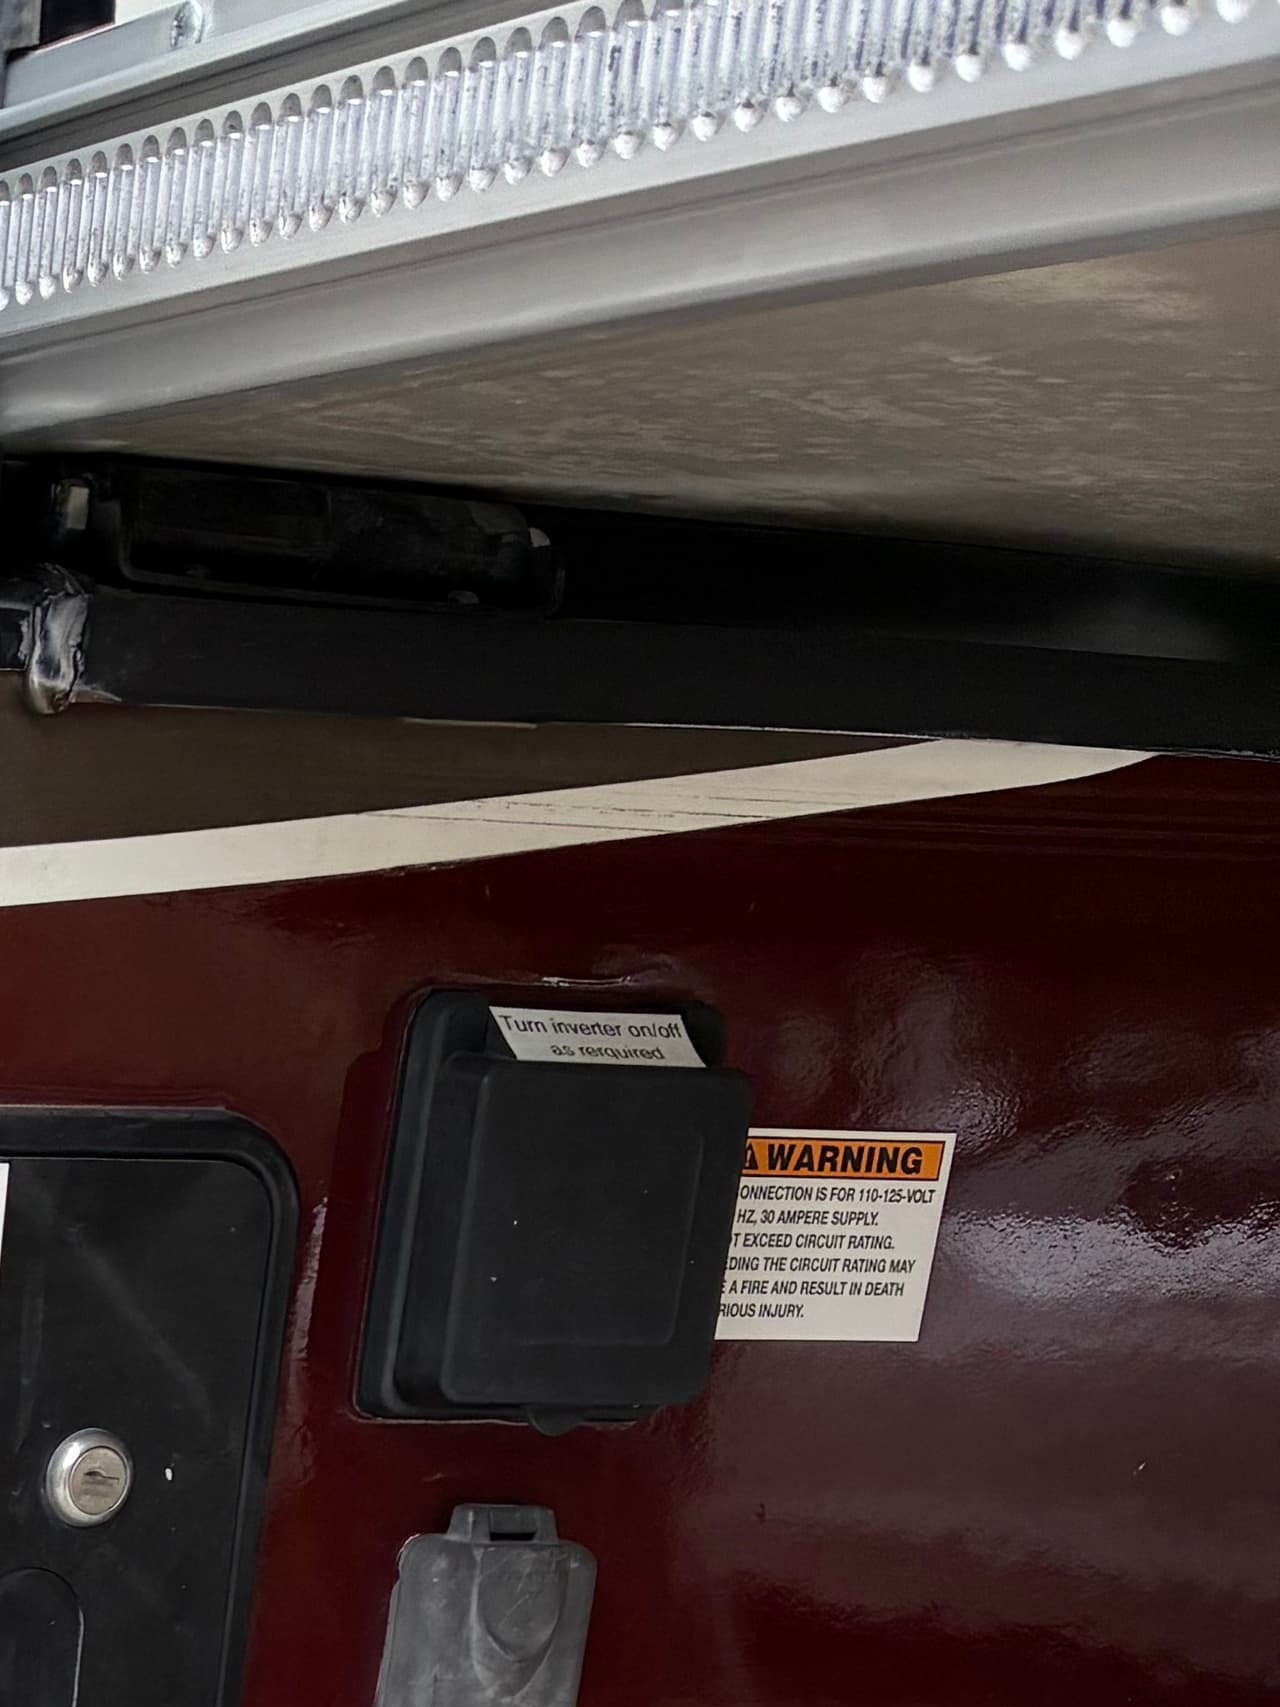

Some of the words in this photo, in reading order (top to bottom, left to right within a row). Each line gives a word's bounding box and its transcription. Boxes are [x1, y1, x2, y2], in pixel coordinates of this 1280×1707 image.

[498, 1015, 547, 1033] Turn
[549, 1018, 622, 1037] inverter
[628, 1022, 683, 1038] on/off
[551, 1044, 575, 1056] as
[767, 1144, 923, 1174] WARNING
[741, 1185, 813, 1200] ONNECTION
[815, 1186, 828, 1200] IS
[830, 1187, 855, 1201] FOR
[859, 1188, 936, 1203] 110-125-VOLT
[737, 1209, 756, 1227] HZ,
[761, 1210, 775, 1224] 30
[777, 1211, 829, 1225] AMPERE
[831, 1211, 879, 1226] SUPPLY.
[743, 1233, 792, 1248] EXCEED
[795, 1234, 846, 1249] CIRCUIT
[848, 1235, 895, 1249] RATING.
[764, 1257, 786, 1271] THE
[790, 1257, 840, 1272] CIRCUIT
[842, 1258, 886, 1273] RATING
[889, 1259, 916, 1273] MAY
[729, 1280, 738, 1294] A
[741, 1280, 768, 1294] FIRE
[771, 1280, 797, 1294] AND
[801, 1281, 847, 1295] RESULT
[849, 1282, 862, 1295] IN
[865, 1282, 904, 1296] DEATH
[719, 1303, 756, 1317] RIOUS
[759, 1304, 805, 1317] INJURY.
